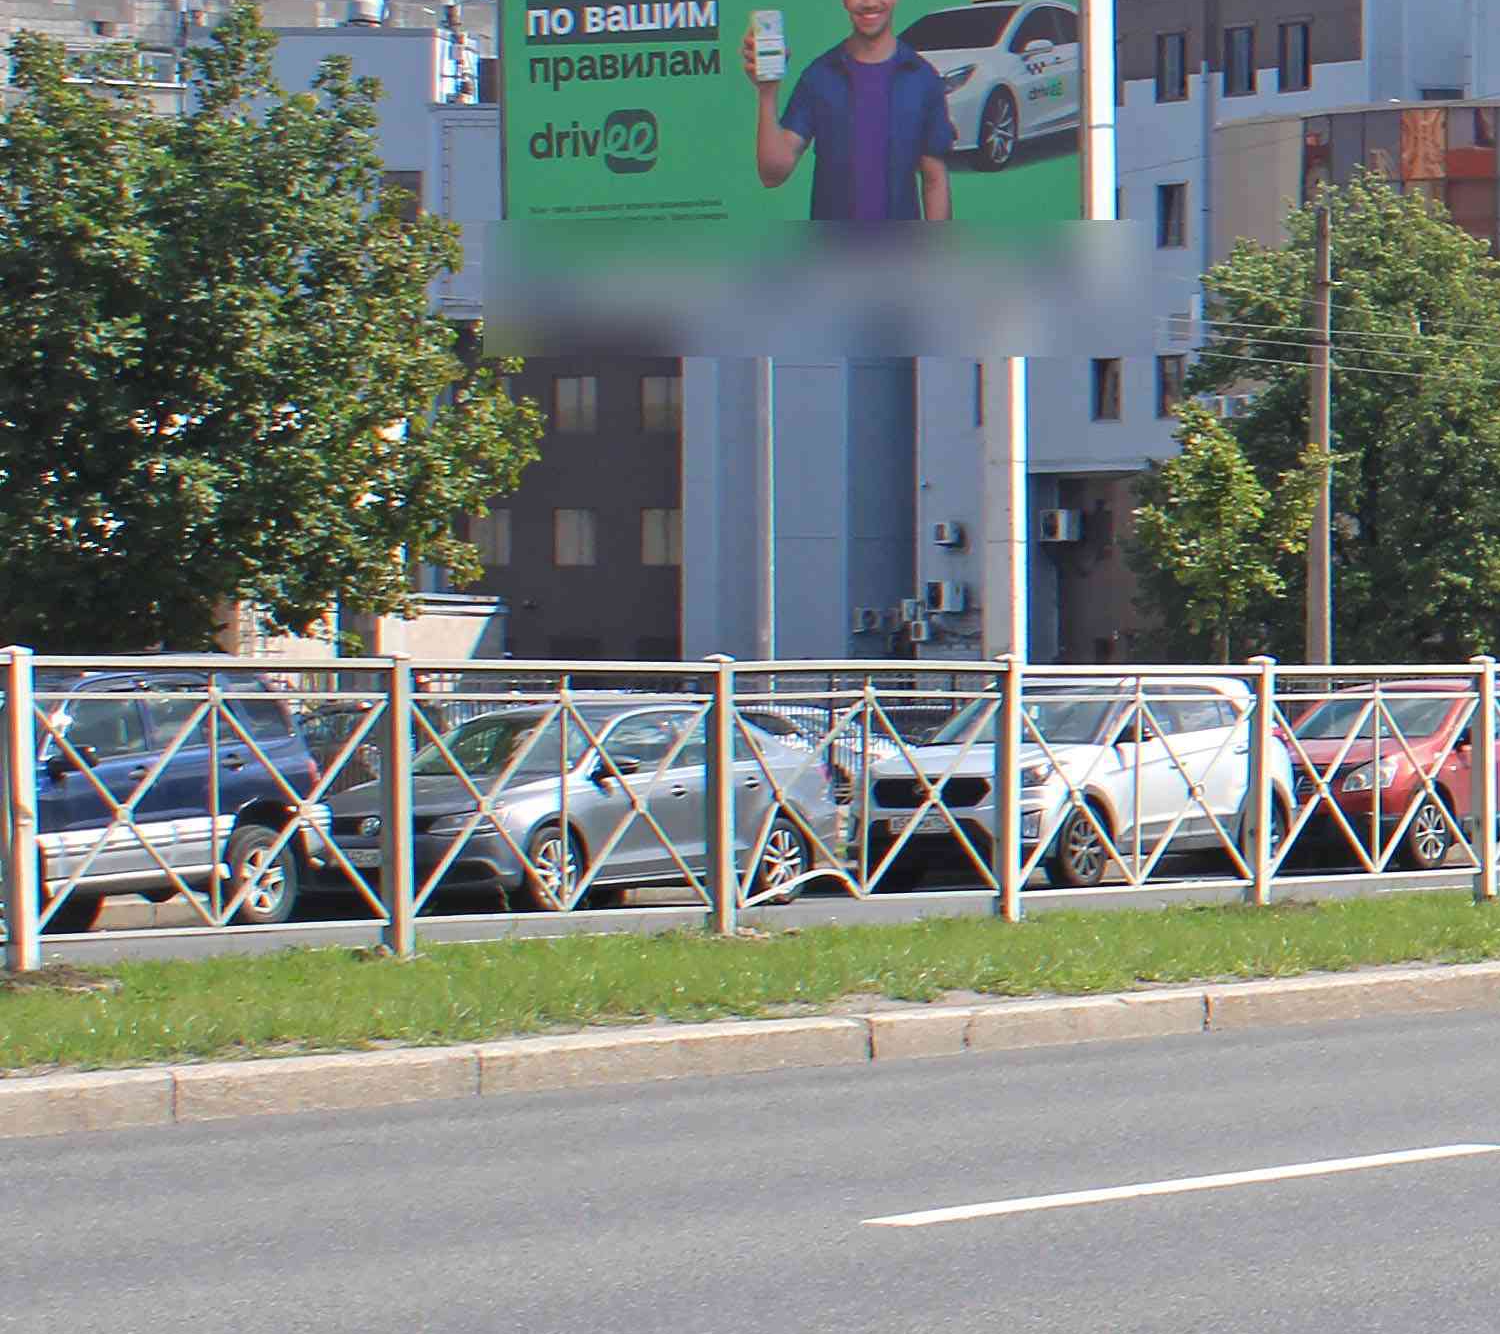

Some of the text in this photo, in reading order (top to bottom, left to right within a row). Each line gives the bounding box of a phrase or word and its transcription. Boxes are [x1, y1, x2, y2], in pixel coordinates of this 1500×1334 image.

[527, 0, 718, 37] по вашим
[530, 48, 721, 90] правилам
[530, 118, 658, 165] drivee
